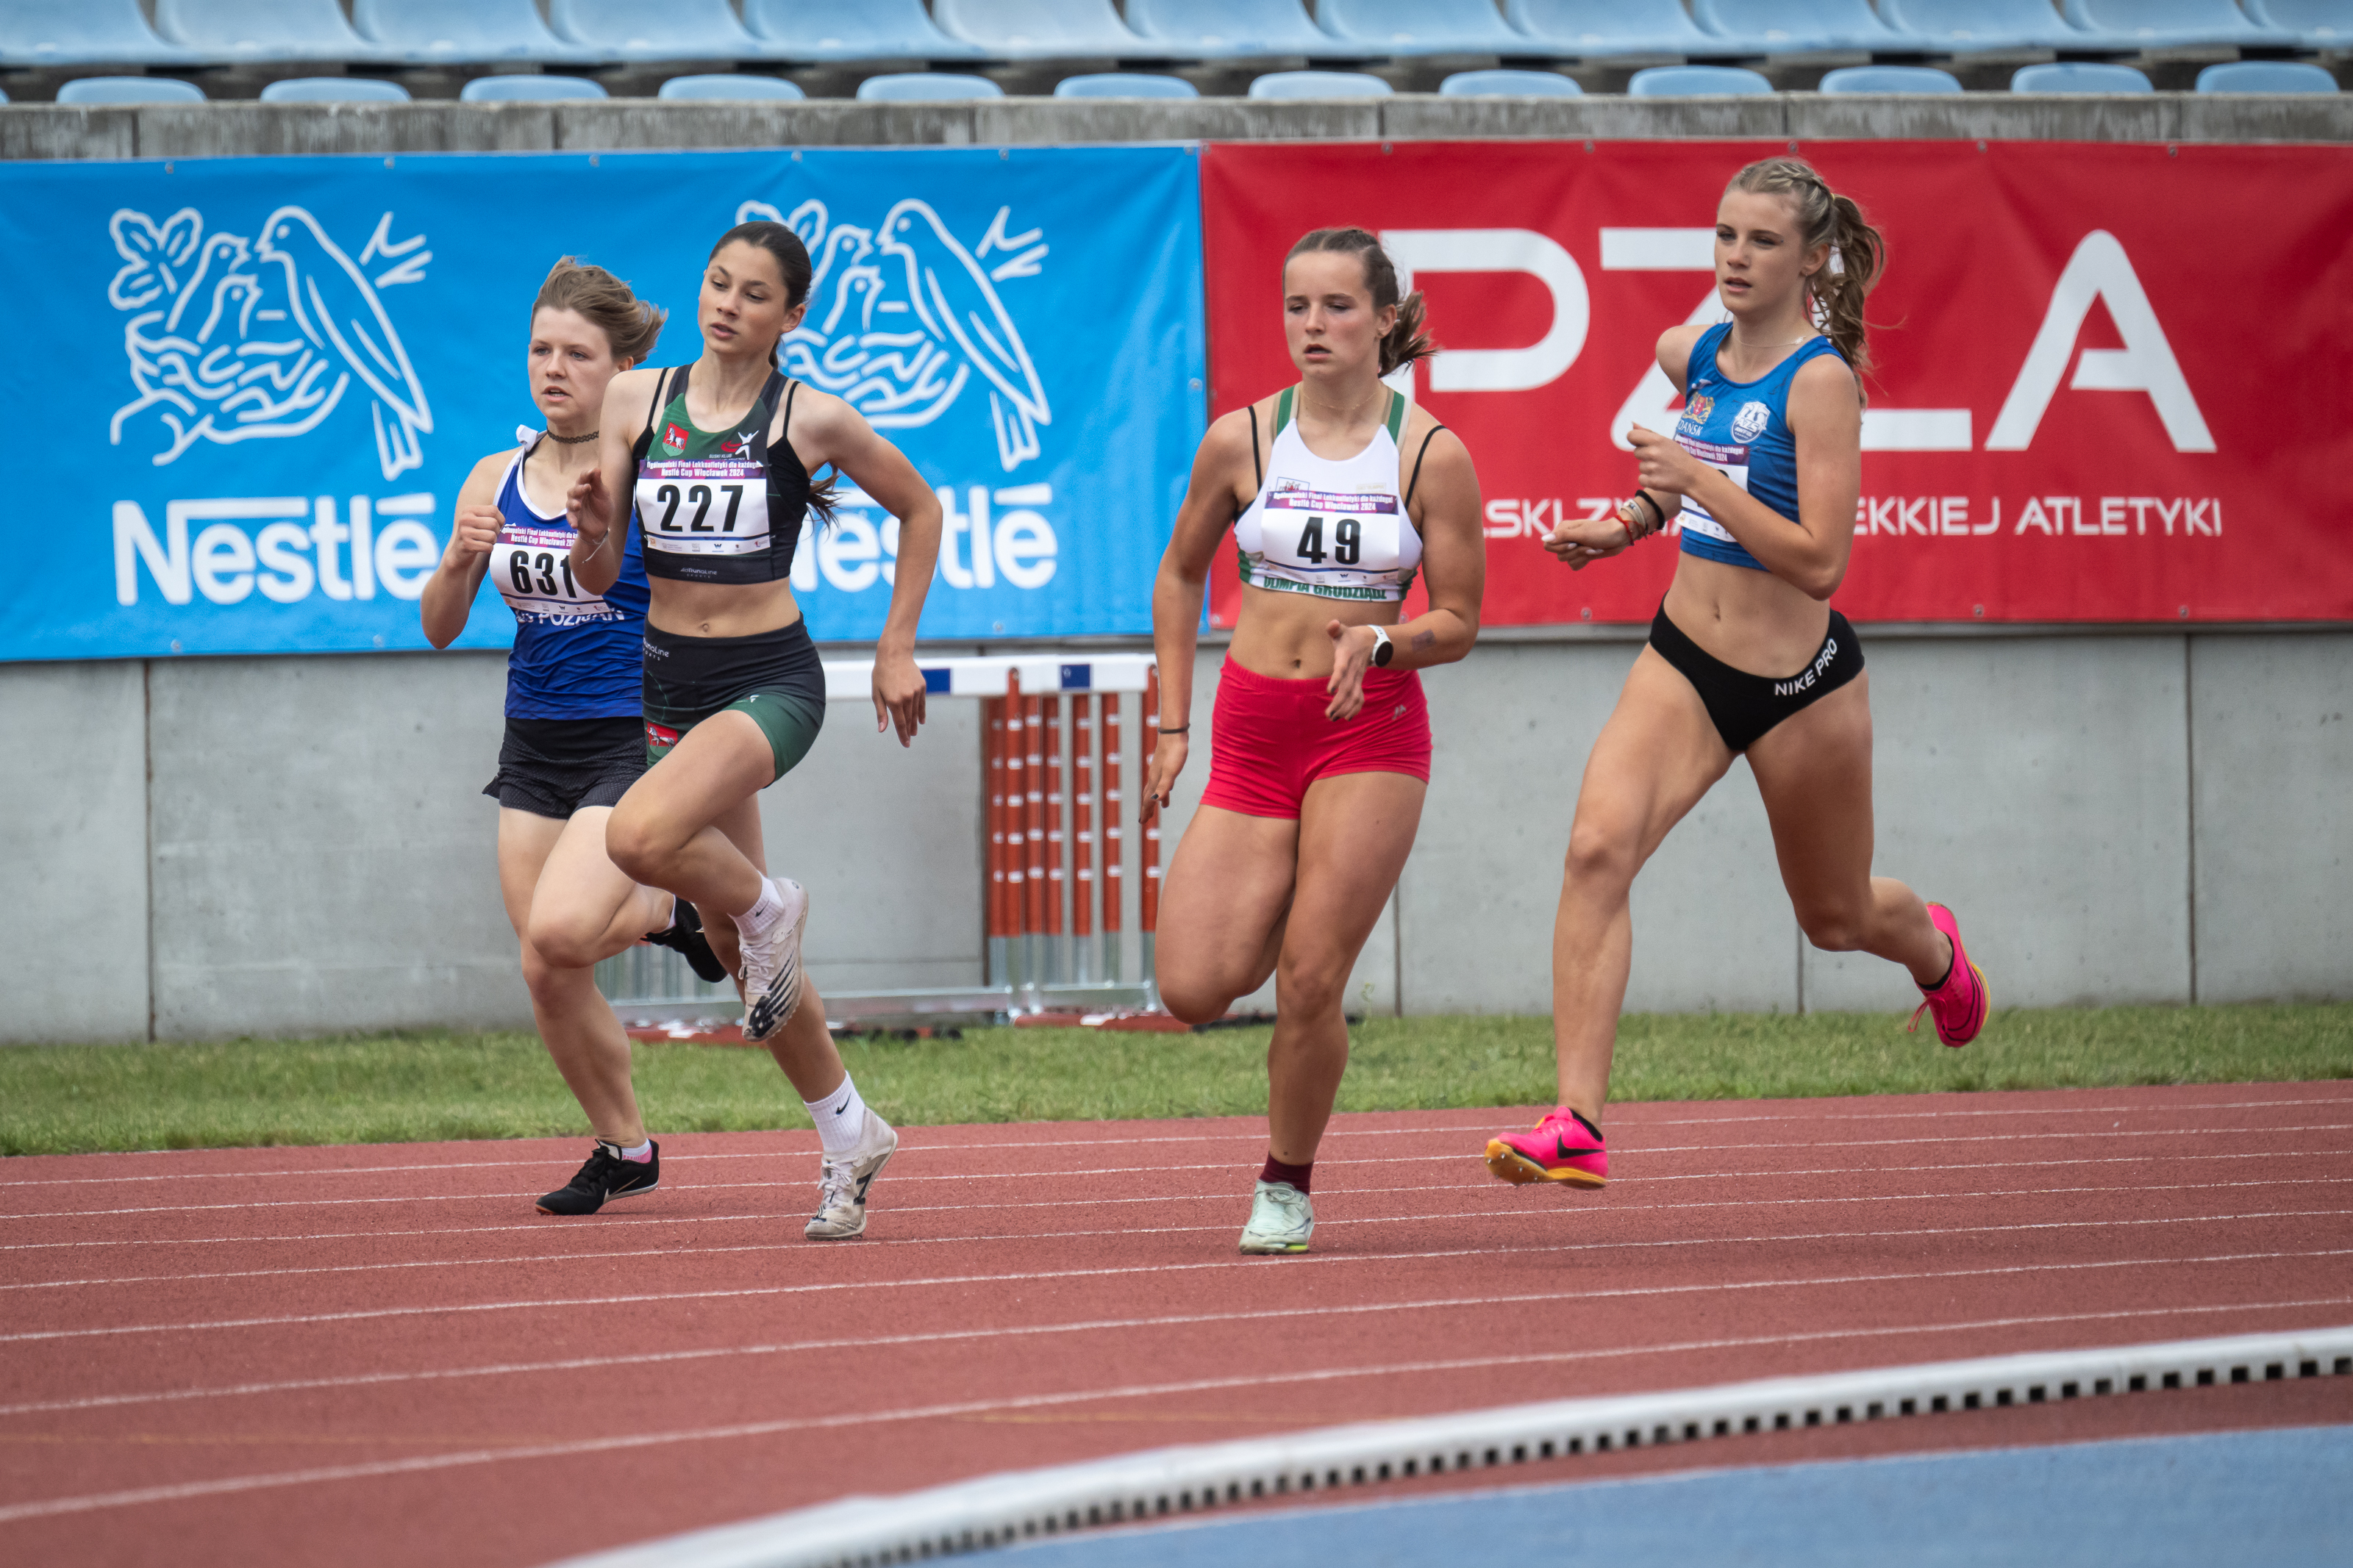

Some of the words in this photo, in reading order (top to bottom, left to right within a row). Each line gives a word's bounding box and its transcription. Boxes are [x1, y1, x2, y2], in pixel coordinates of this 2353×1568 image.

[661, 468, 679, 476] Nestlé
[681, 468, 693, 477] Cup
[694, 468, 728, 476] Włocławek
[729, 468, 744, 476] 2024
[657, 484, 743, 532] 227
[1289, 498, 1310, 508] Nestlé
[1311, 499, 1324, 509] Cup
[1324, 500, 1360, 510] Włocławek
[1361, 502, 1377, 510] 2024
[1484, 498, 1563, 538] SKI
[2015, 496, 2222, 537] ATLETYKI
[112, 493, 440, 605] Nestlé
[528, 535, 538, 545] Cup
[565, 539, 575, 547] 202
[1296, 516, 1361, 565] 49
[510, 550, 577, 598] 631
[1774, 669, 1815, 695] NIKE
[1815, 638, 1838, 676] PRO
